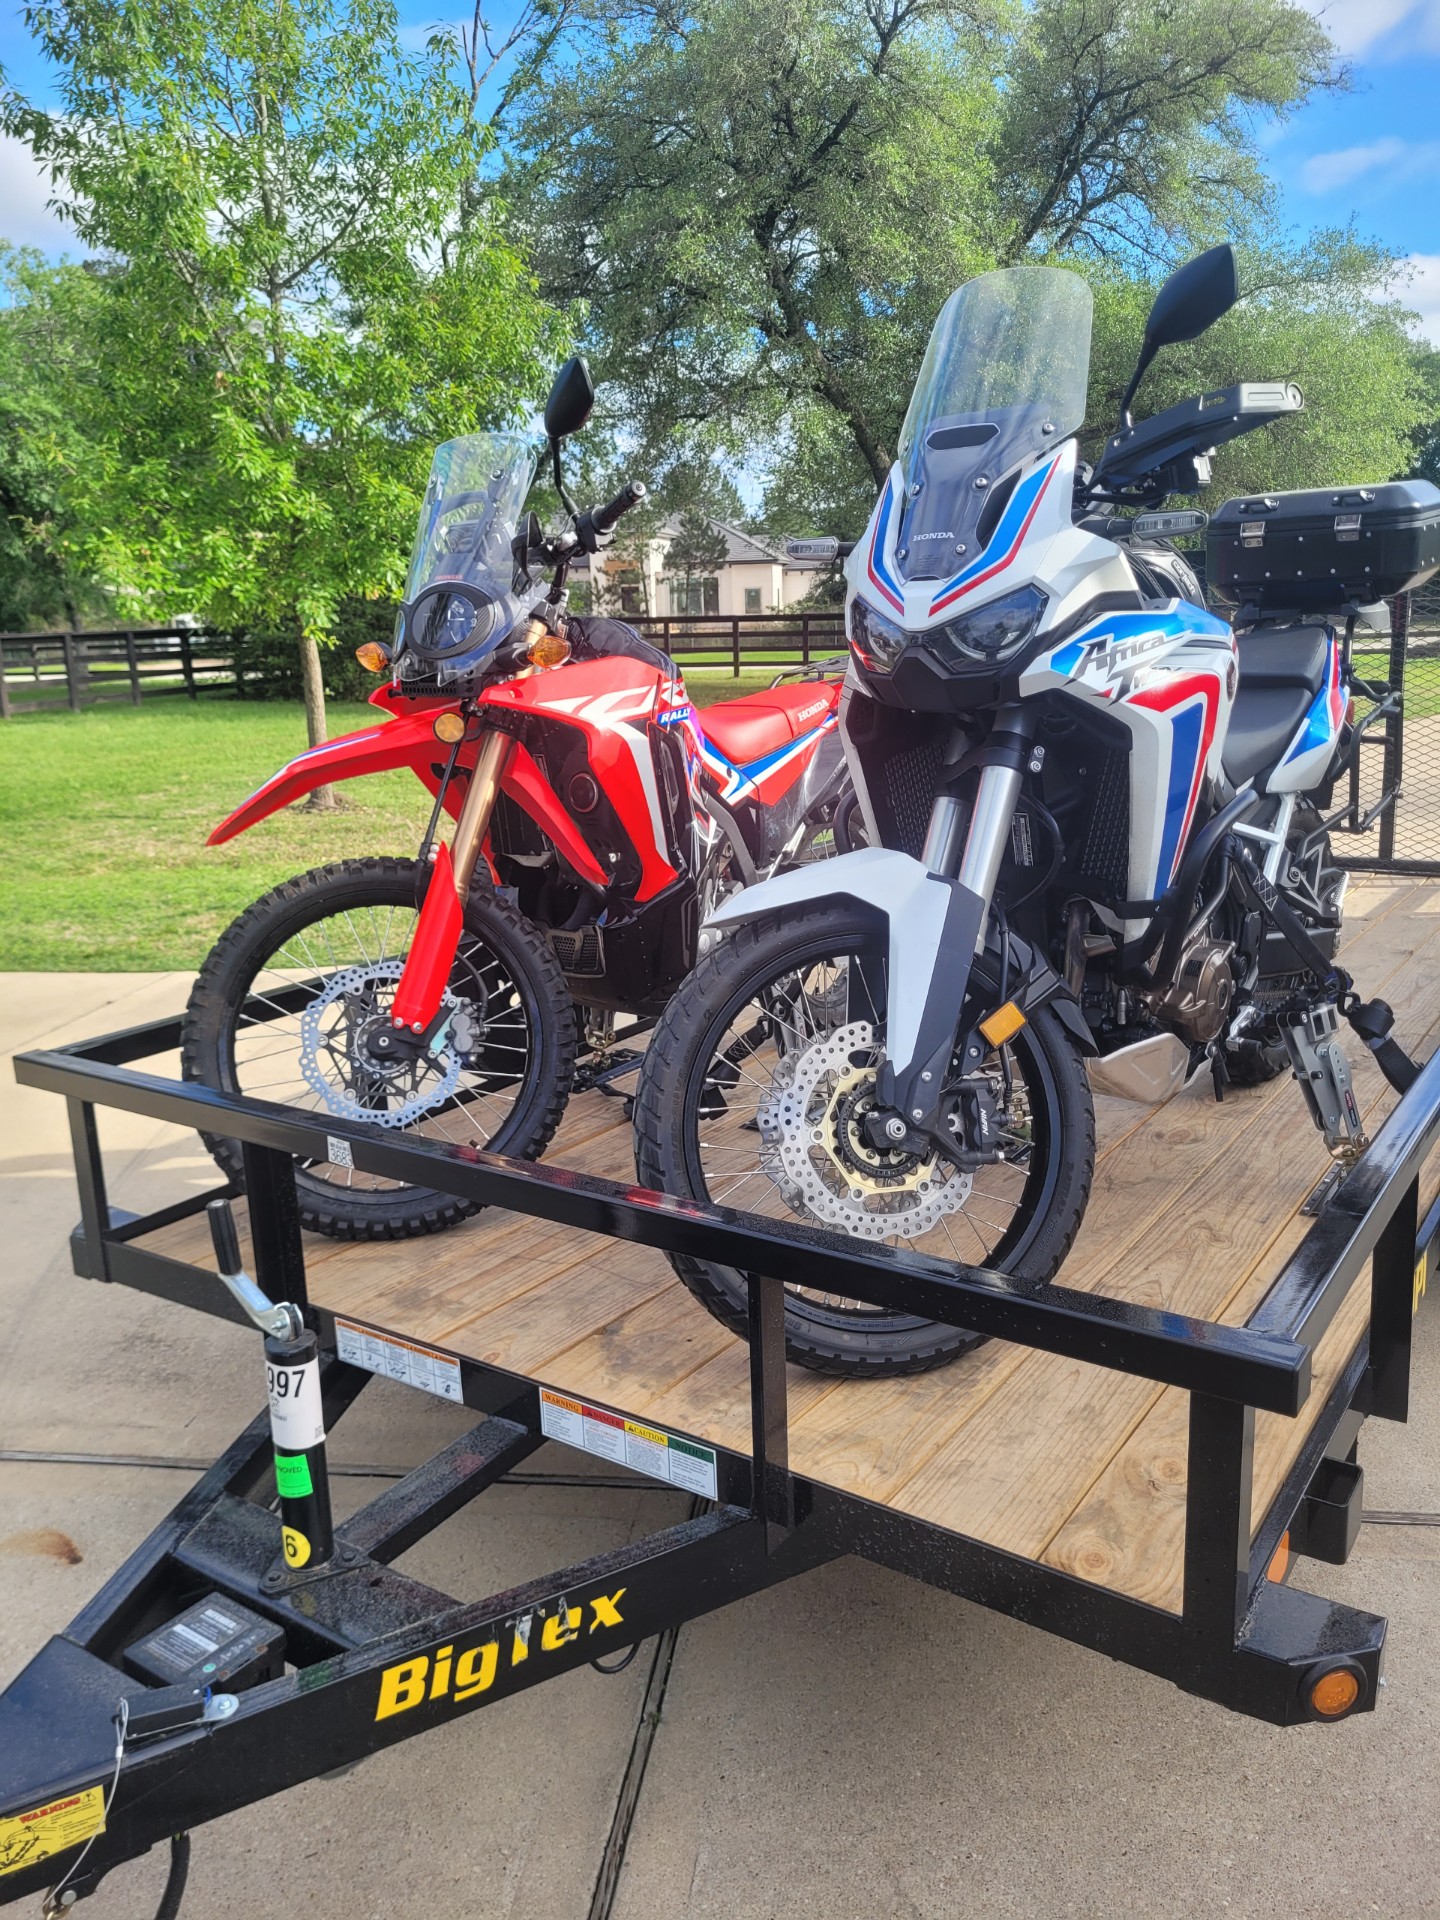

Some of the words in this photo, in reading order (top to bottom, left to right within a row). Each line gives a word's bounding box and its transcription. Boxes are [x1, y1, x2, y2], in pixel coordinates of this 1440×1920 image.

[913, 532, 955, 541] HONDA
[1061, 634, 1182, 687] Africa
[660, 707, 691, 724] RALLY
[797, 698, 829, 722] HONDA
[545, 1393, 579, 1412] WARNING
[592, 1410, 621, 1427] DANGER
[634, 1427, 665, 1443] CAUTION
[676, 1441, 705, 1457] NOTICE
[285, 1534, 298, 1558] 6
